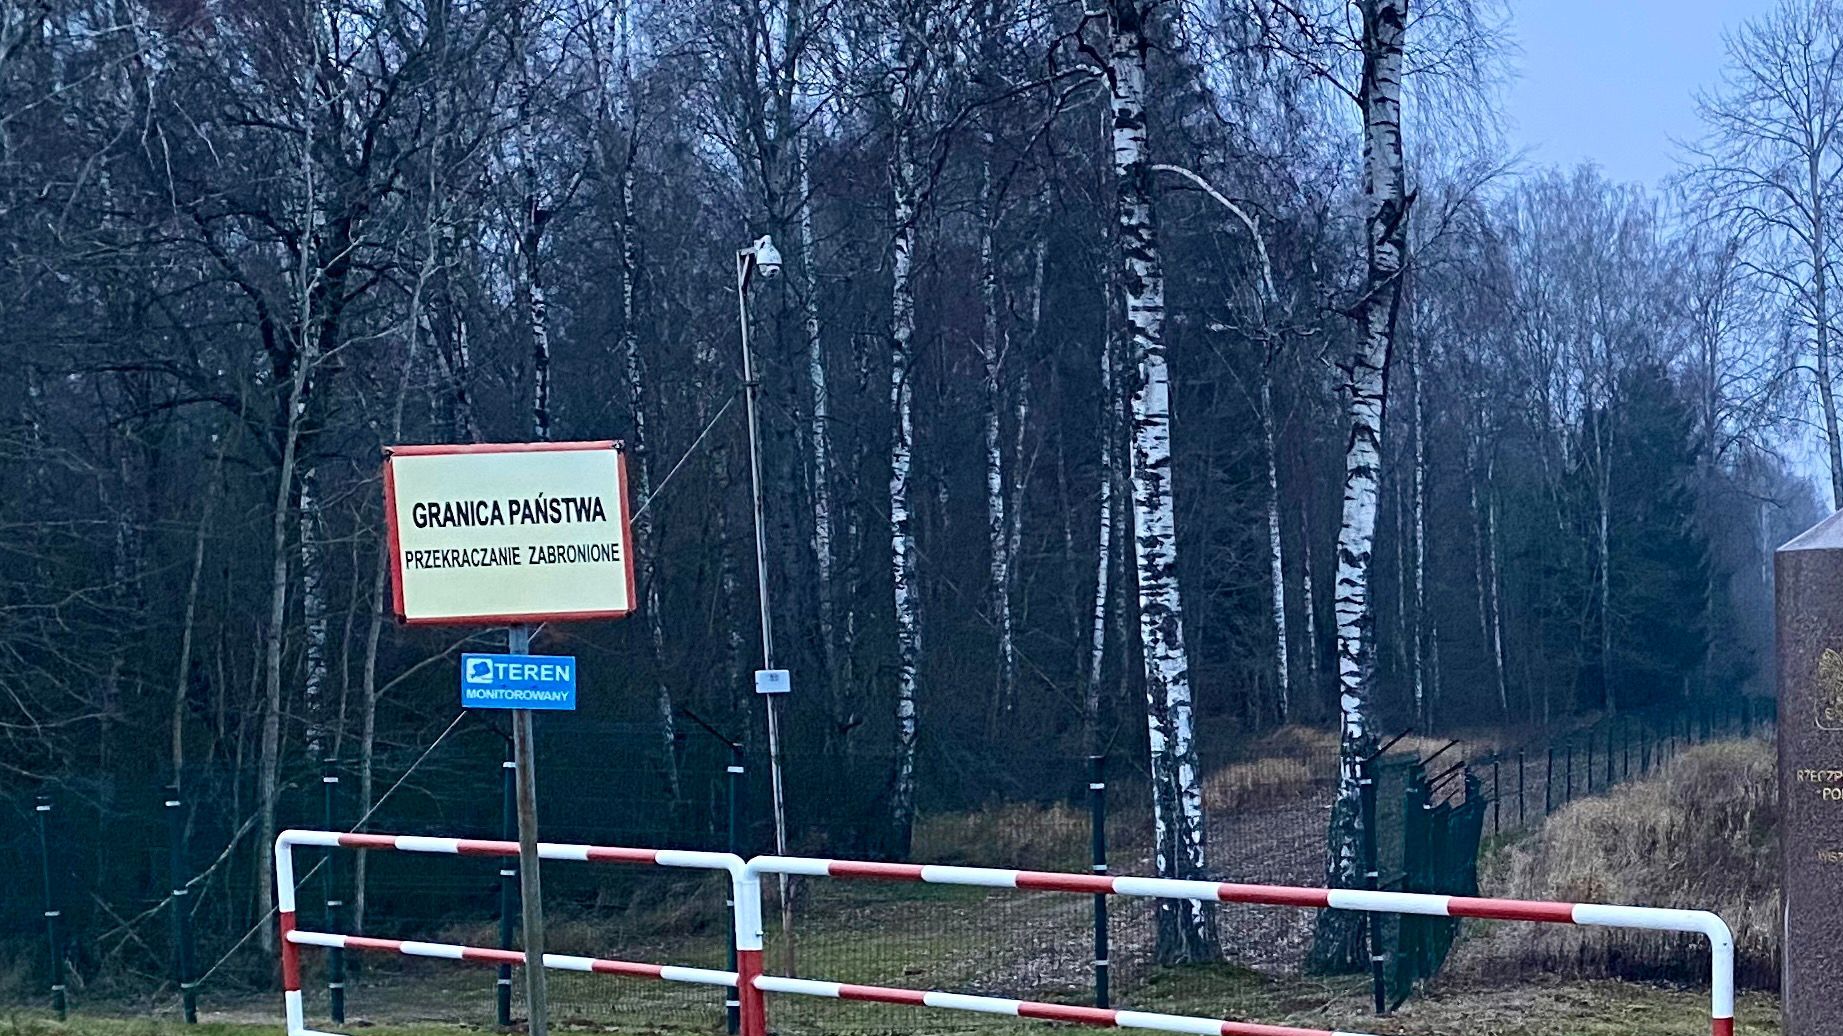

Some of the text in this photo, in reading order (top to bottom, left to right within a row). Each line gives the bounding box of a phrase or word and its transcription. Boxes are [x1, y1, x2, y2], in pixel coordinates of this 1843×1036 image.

[412, 491, 607, 528] GRANICA PAŃSTWA
[405, 543, 620, 569] PRZEKRACZANIE ZABRONIONE
[494, 662, 570, 682] TEREN
[466, 688, 569, 702] MONITOROWANY
